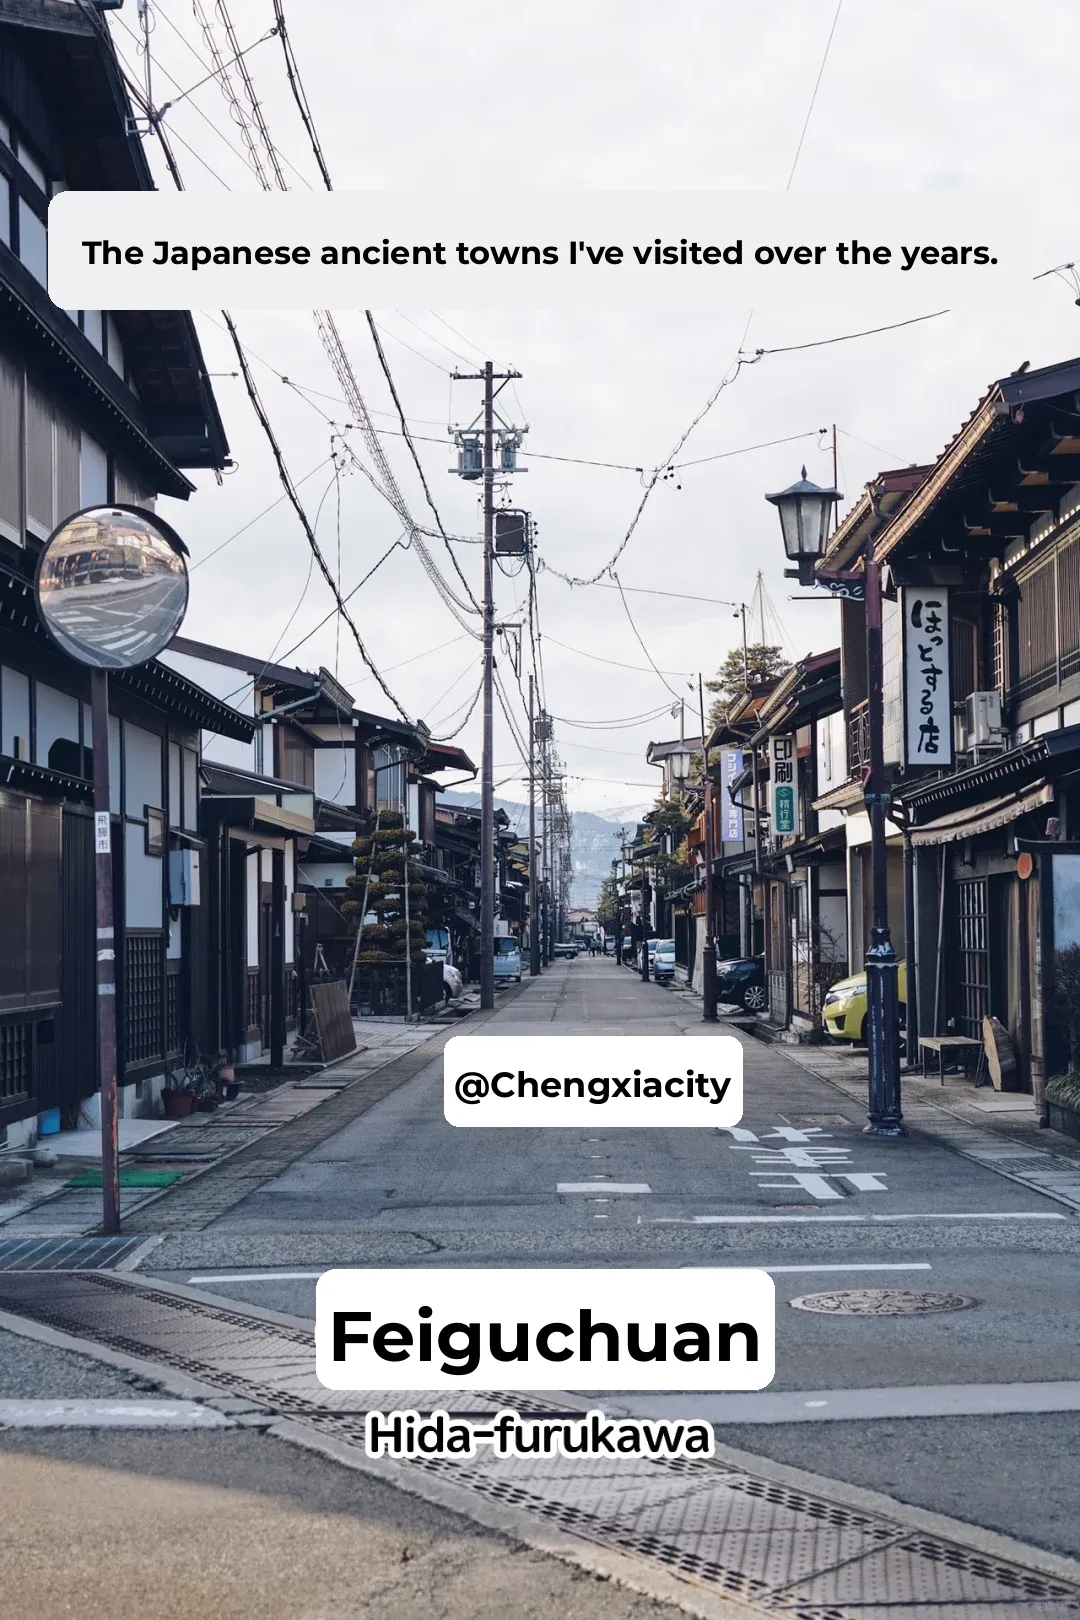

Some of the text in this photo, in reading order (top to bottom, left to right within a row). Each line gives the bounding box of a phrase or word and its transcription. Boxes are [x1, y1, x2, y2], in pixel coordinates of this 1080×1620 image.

[910, 600, 944, 755] ほっとする店
[773, 739, 793, 784] 印刷
